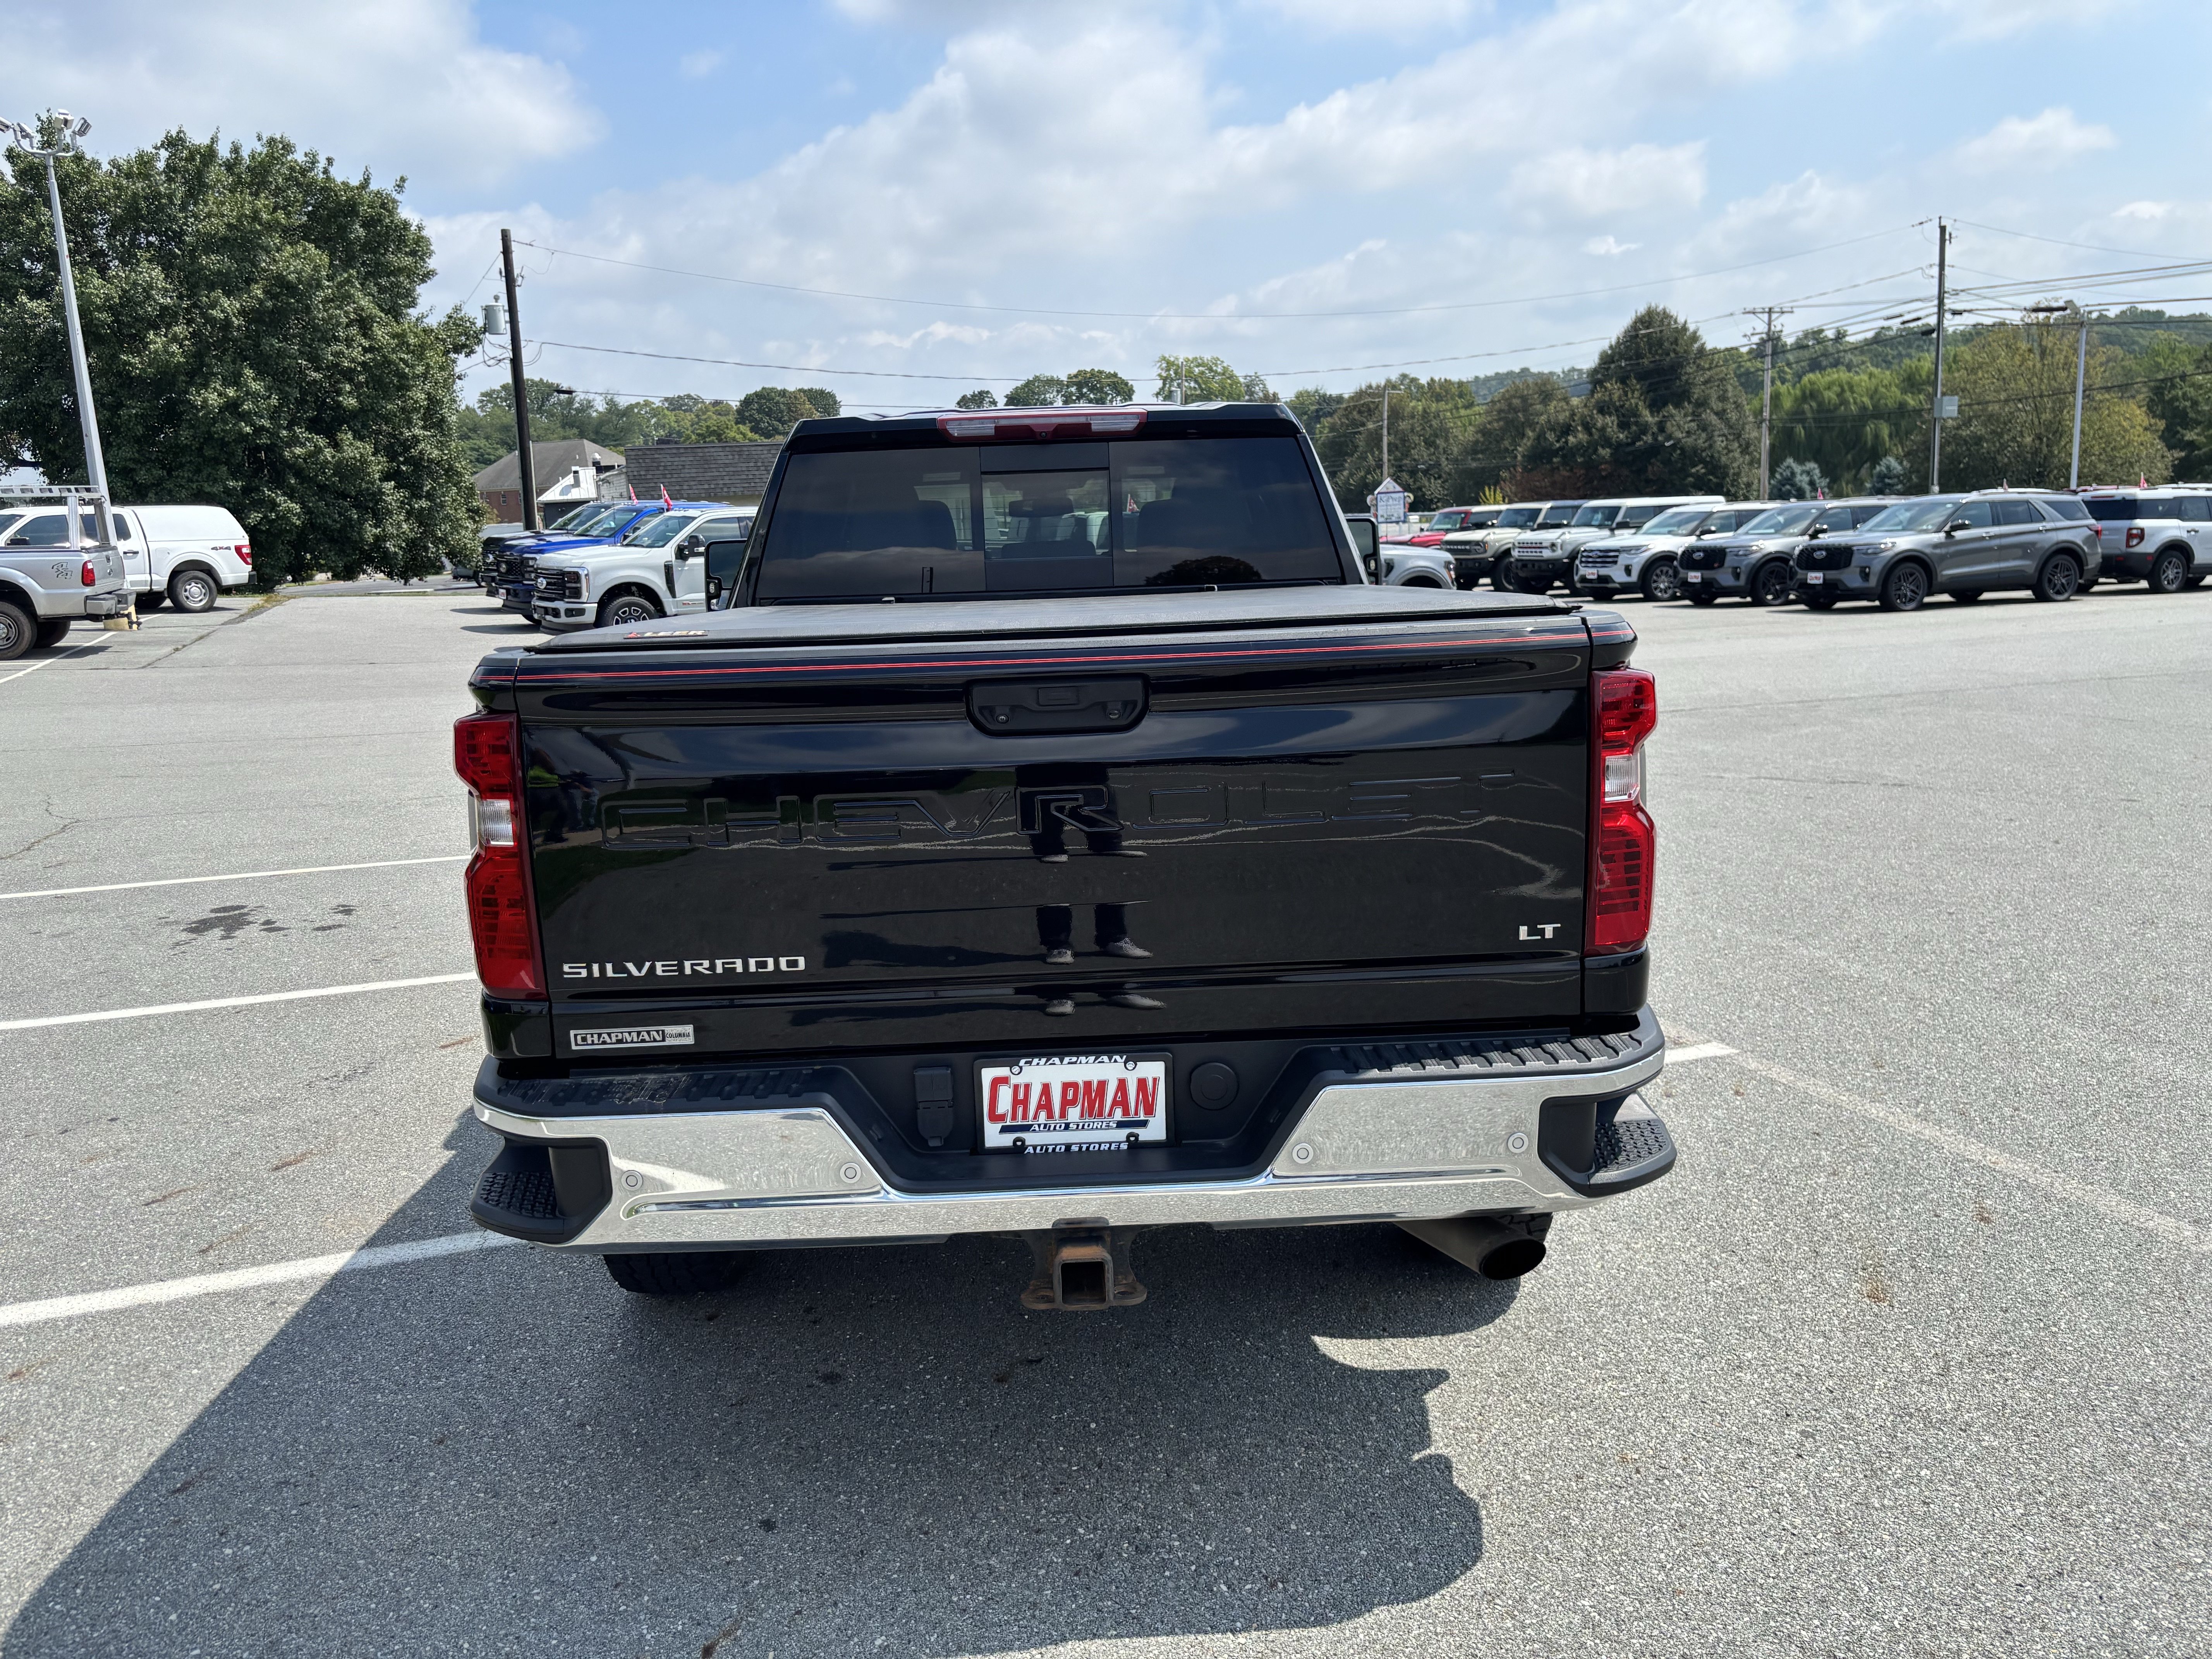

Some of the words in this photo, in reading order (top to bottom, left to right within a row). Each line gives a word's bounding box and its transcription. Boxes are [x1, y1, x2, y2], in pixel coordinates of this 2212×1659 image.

[601, 768, 1516, 850] CHEVROLET
[1519, 924, 1561, 940] LT
[563, 957, 805, 977] SILVERADO
[577, 1030, 663, 1044] CHAPMAN
[1019, 1055, 1127, 1066] CHAPMAN
[986, 1075, 1160, 1123] CHAPMAN
[1029, 1123, 1065, 1132] AUTO
[1068, 1121, 1118, 1130] STORES
[1024, 1145, 1065, 1154] AUTO
[1070, 1142, 1128, 1151] STORES
